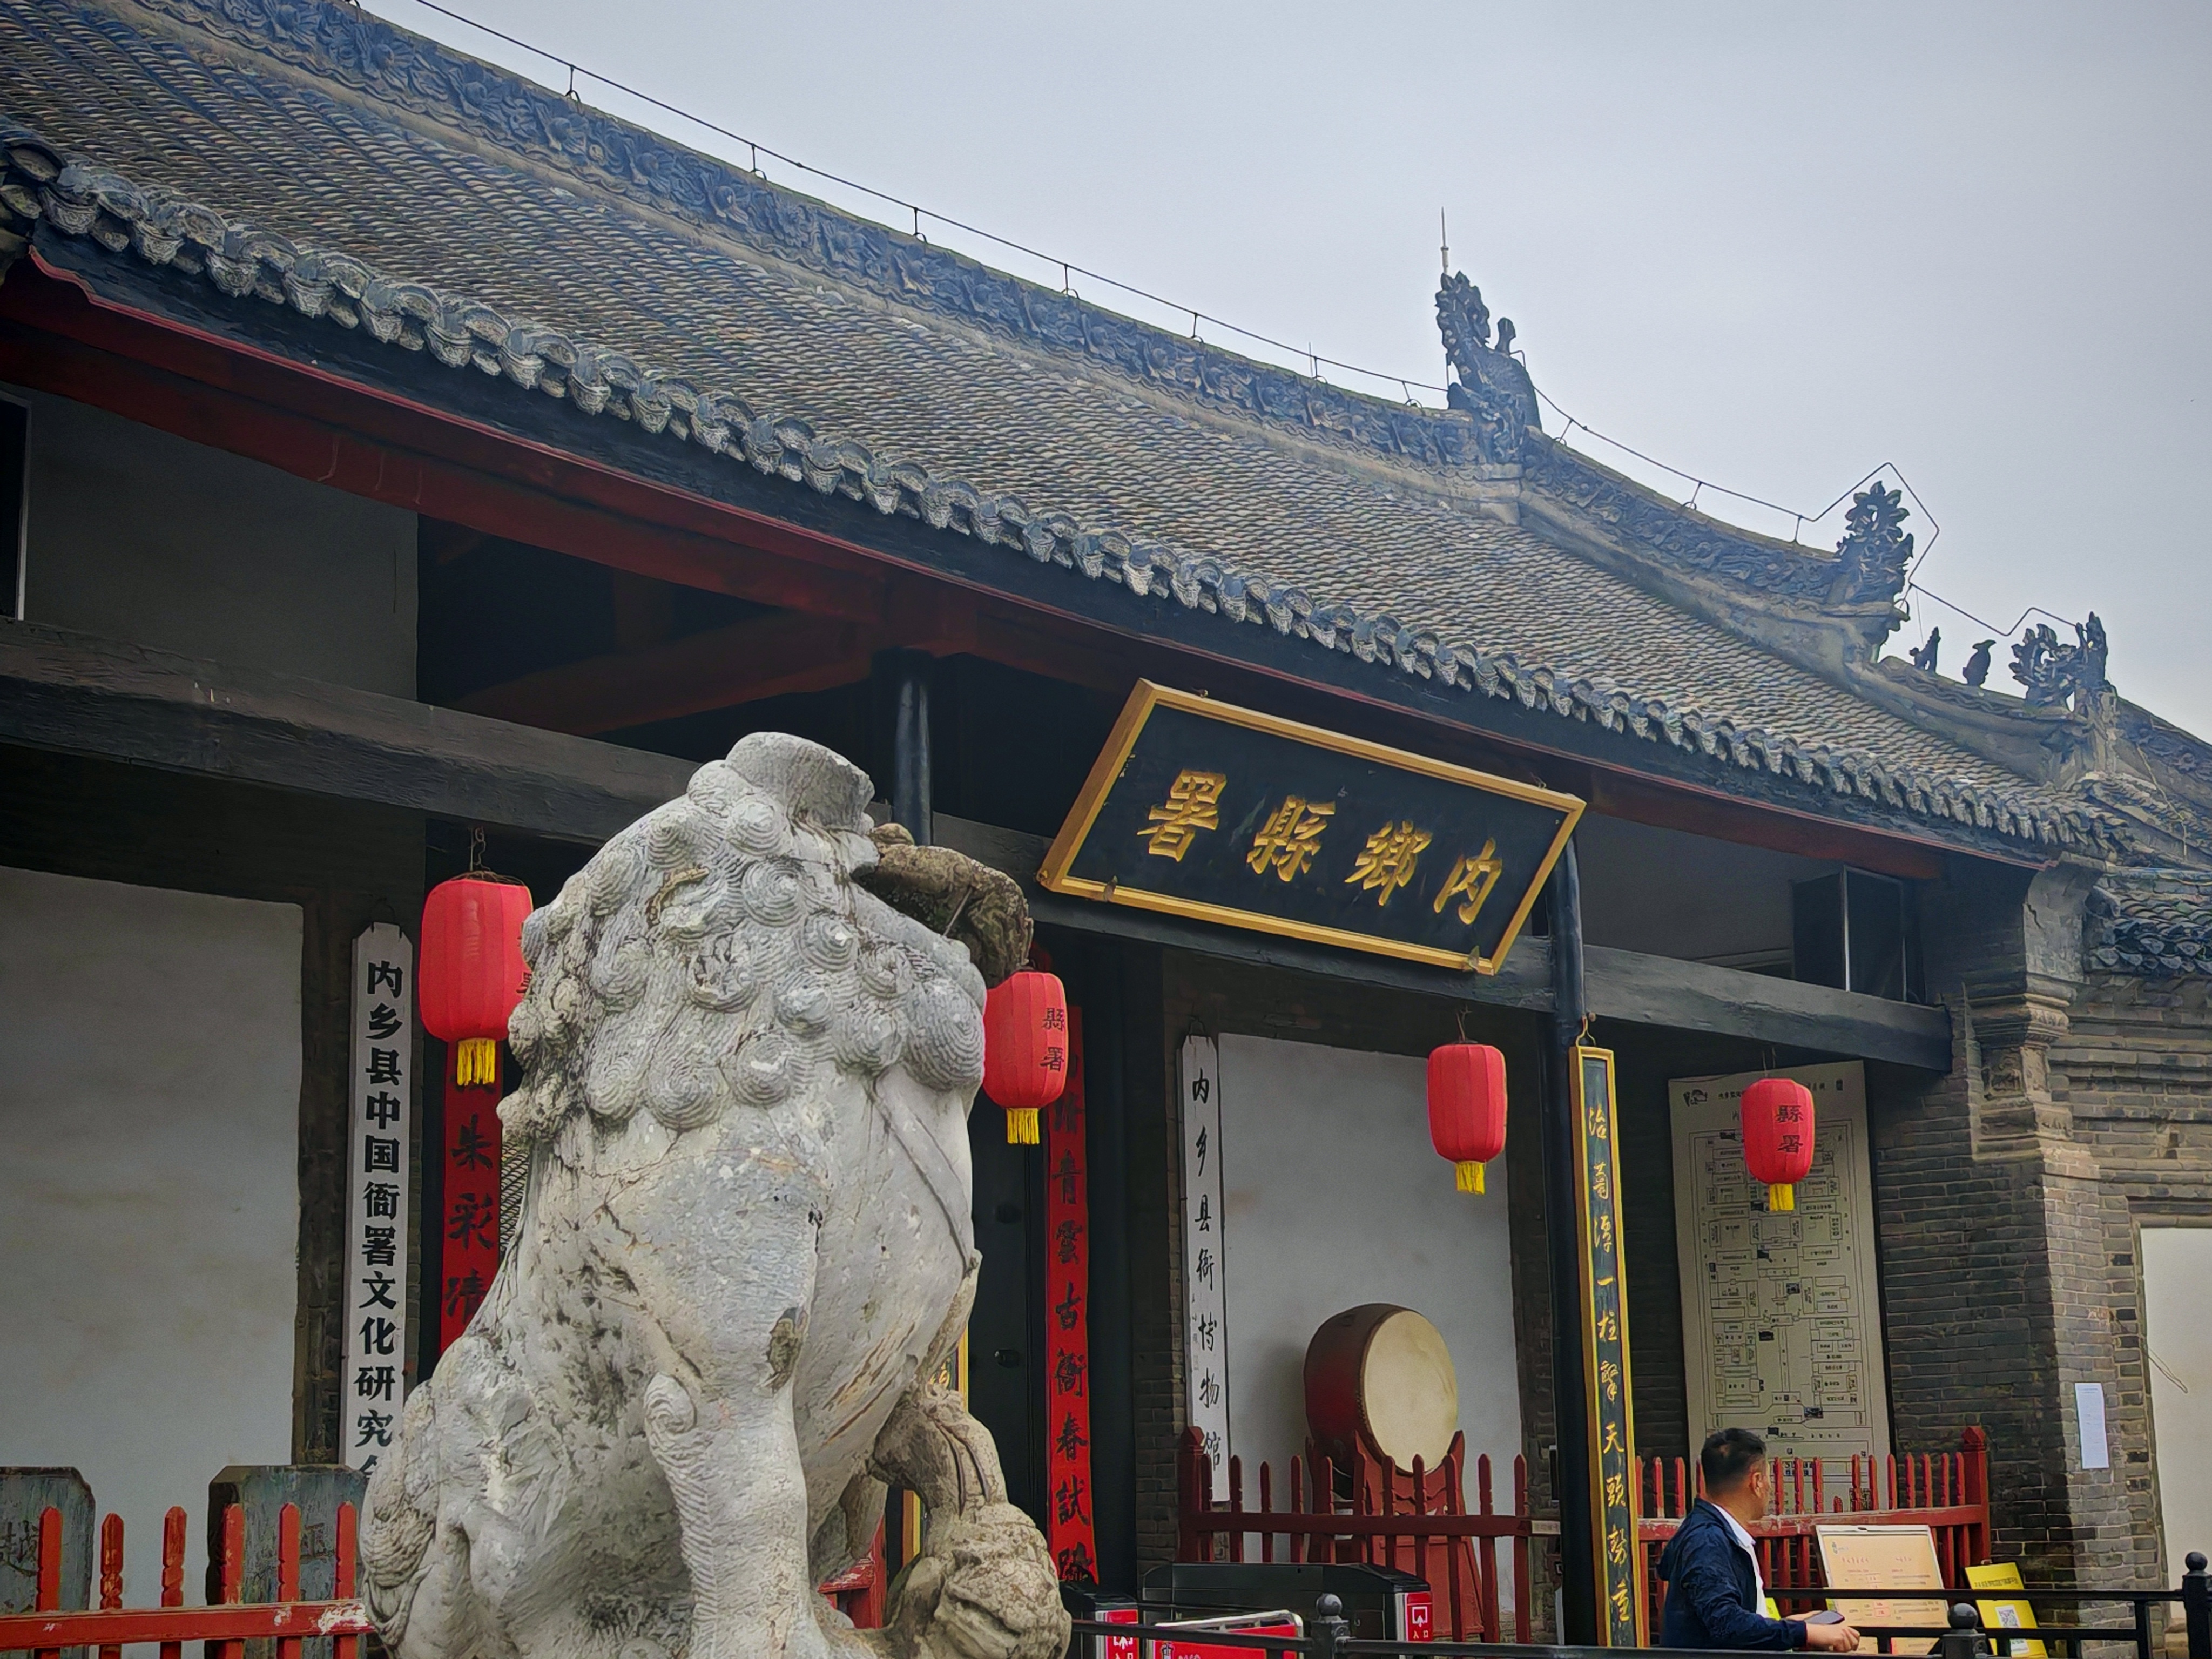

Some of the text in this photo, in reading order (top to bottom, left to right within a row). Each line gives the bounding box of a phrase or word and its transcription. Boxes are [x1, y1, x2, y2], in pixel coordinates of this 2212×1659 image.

[1192, 1067, 1222, 1471] 内乡县衙博物馆
[1413, 1630, 1429, 1640] 入口
